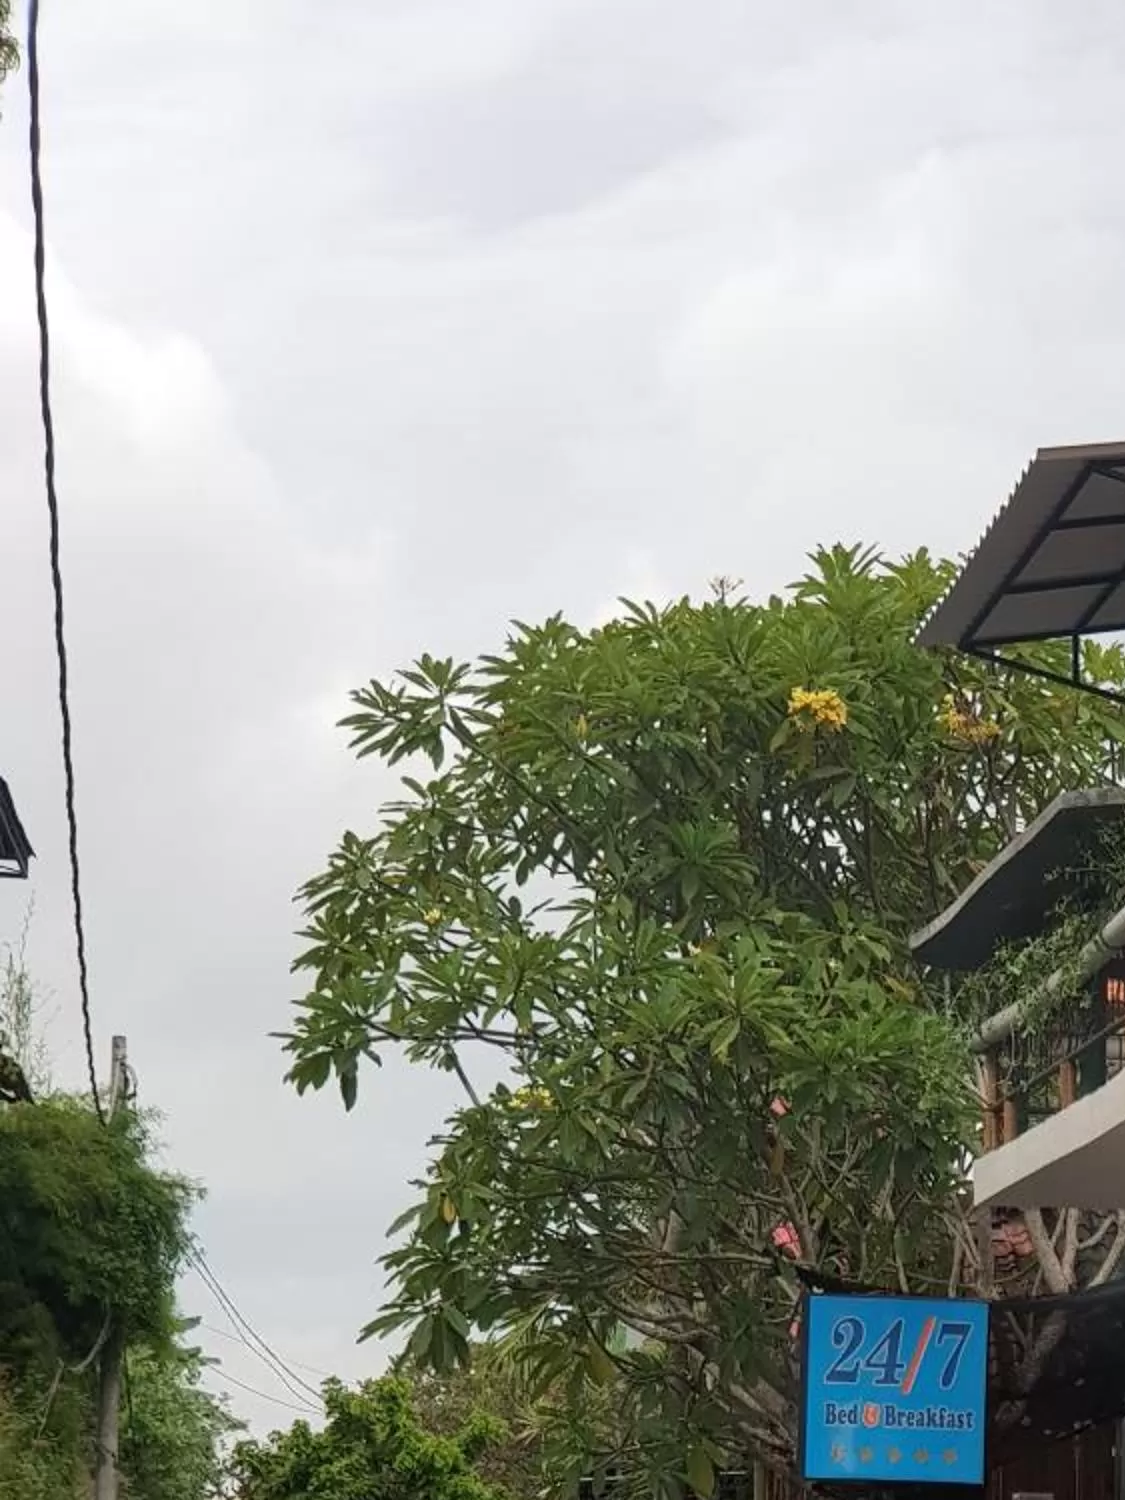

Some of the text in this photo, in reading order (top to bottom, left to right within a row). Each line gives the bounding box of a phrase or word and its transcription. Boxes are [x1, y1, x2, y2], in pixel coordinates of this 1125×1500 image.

[824, 1315, 974, 1395] 24/7
[824, 1402, 859, 1426] Bed
[883, 1404, 974, 1430] Breakfast
